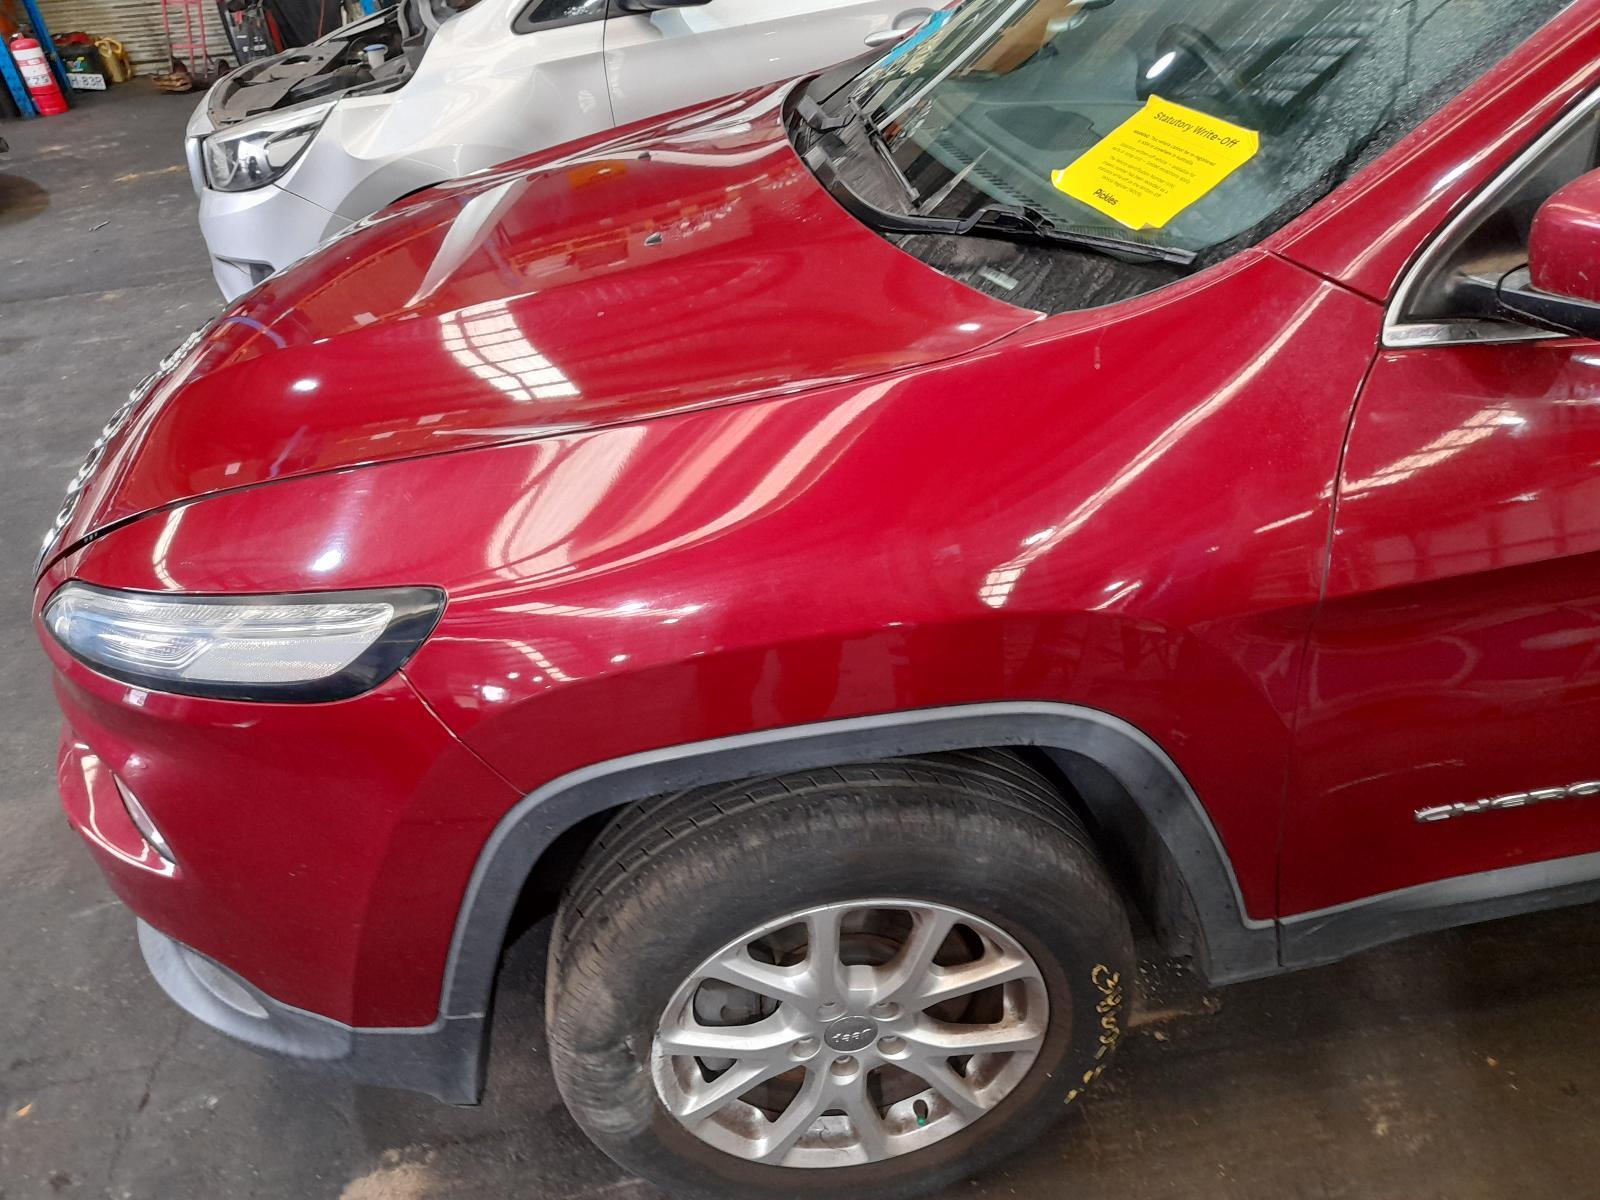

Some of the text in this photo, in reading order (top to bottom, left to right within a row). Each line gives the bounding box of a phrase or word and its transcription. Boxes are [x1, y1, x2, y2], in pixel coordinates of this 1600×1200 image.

[1154, 111, 1193, 133] Statutory
[1193, 125, 1240, 149] Write-Off
[1093, 188, 1119, 206] Pickles
